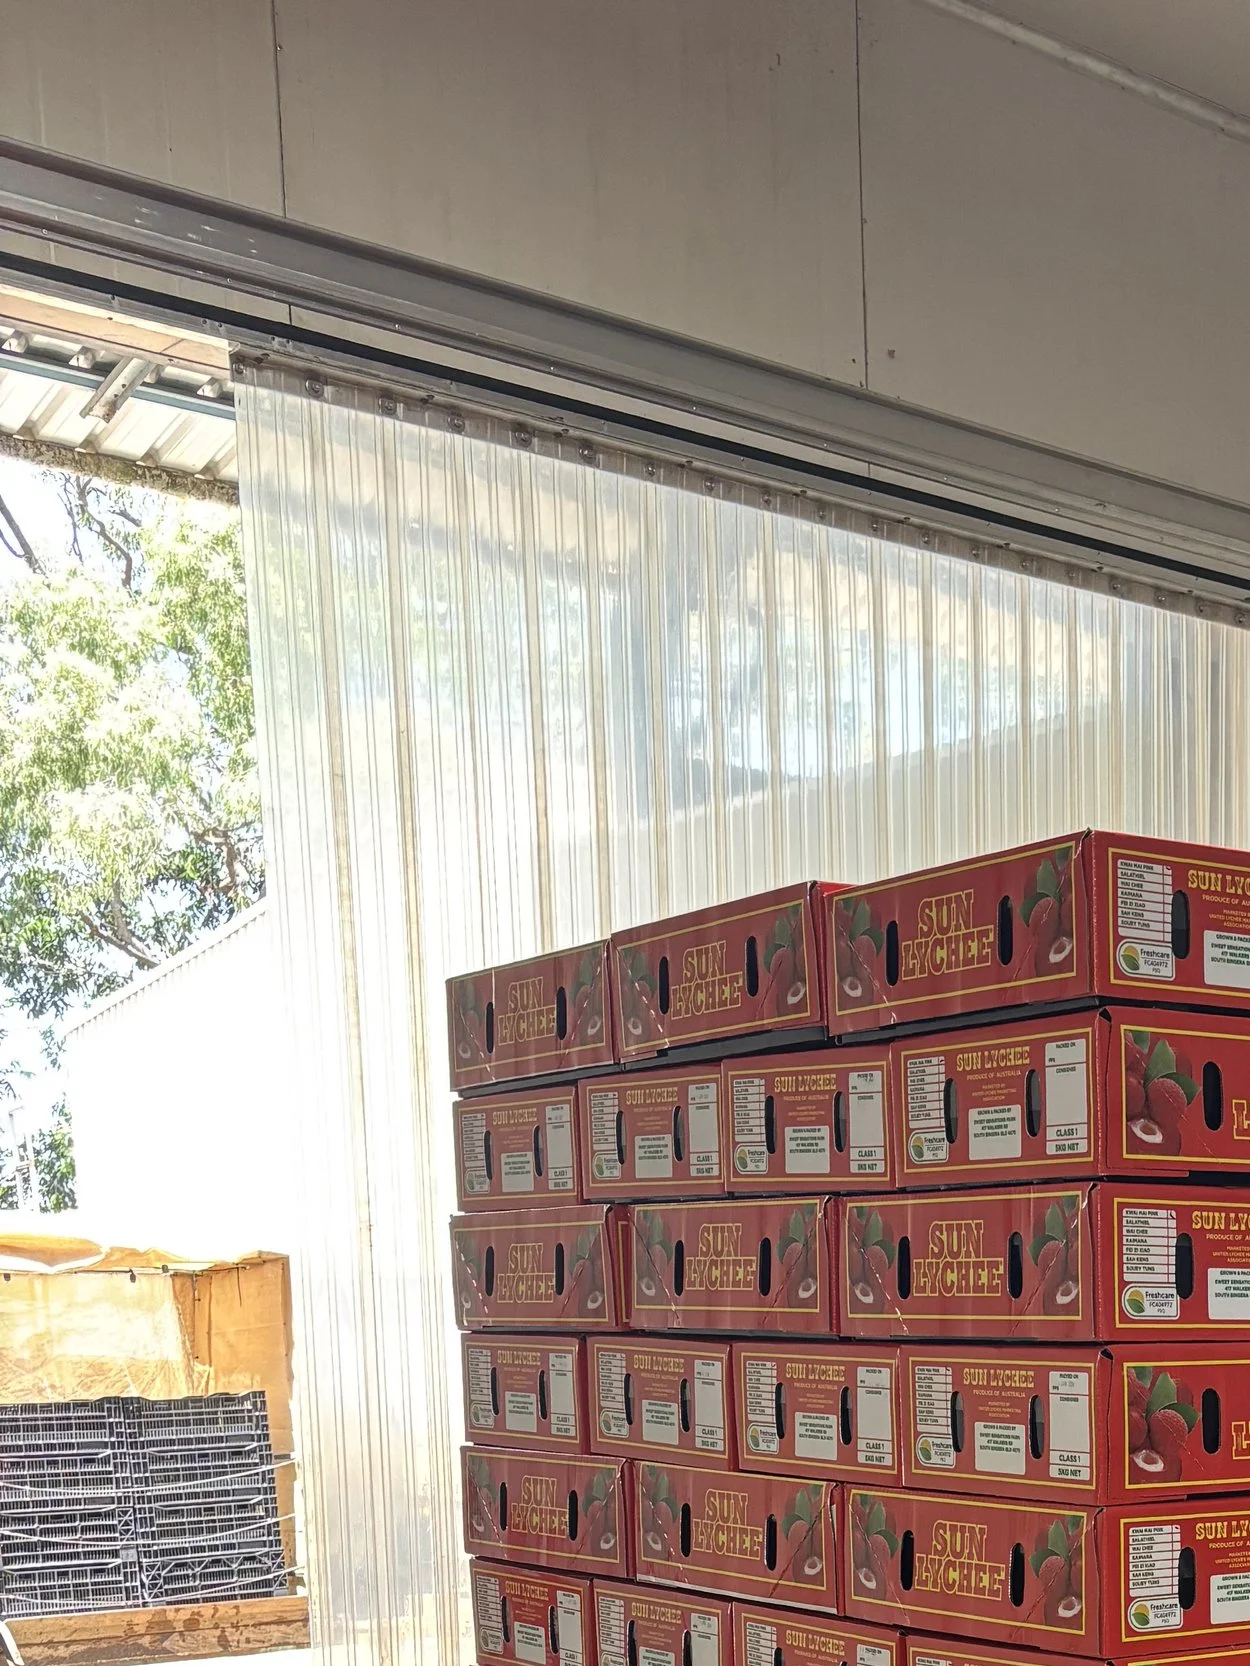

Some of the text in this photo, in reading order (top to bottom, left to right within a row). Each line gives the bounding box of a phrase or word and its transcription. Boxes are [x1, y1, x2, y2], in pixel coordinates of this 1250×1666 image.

[1188, 868, 1222, 892] SUN
[918, 890, 975, 936] SUN
[1202, 894, 1230, 904] PRODUCE
[683, 940, 727, 985] SUN
[902, 920, 994, 981] LYCHEE
[1140, 948, 1170, 959] Freshcare
[507, 976, 545, 1012] SUN
[671, 970, 743, 1021] LYCHEE
[498, 1006, 557, 1044] LYCHEE
[956, 1044, 1030, 1072] SUN LYCHEE
[1055, 1142, 1078, 1152] 5KG NET
[1056, 1128, 1073, 1137] CLASS
[1192, 1210, 1226, 1230] SUN
[699, 1224, 742, 1262] SUN
[928, 1221, 986, 1261] SUN
[685, 1256, 757, 1291] LYCHEE
[913, 1257, 1004, 1297] LYCHEE
[1145, 1291, 1174, 1299] Freshcare
[522, 1476, 557, 1509] SUN
[512, 1505, 568, 1539] LYCHEE
[931, 1520, 987, 1562] SUN
[915, 1554, 1006, 1602] LYCHEE
